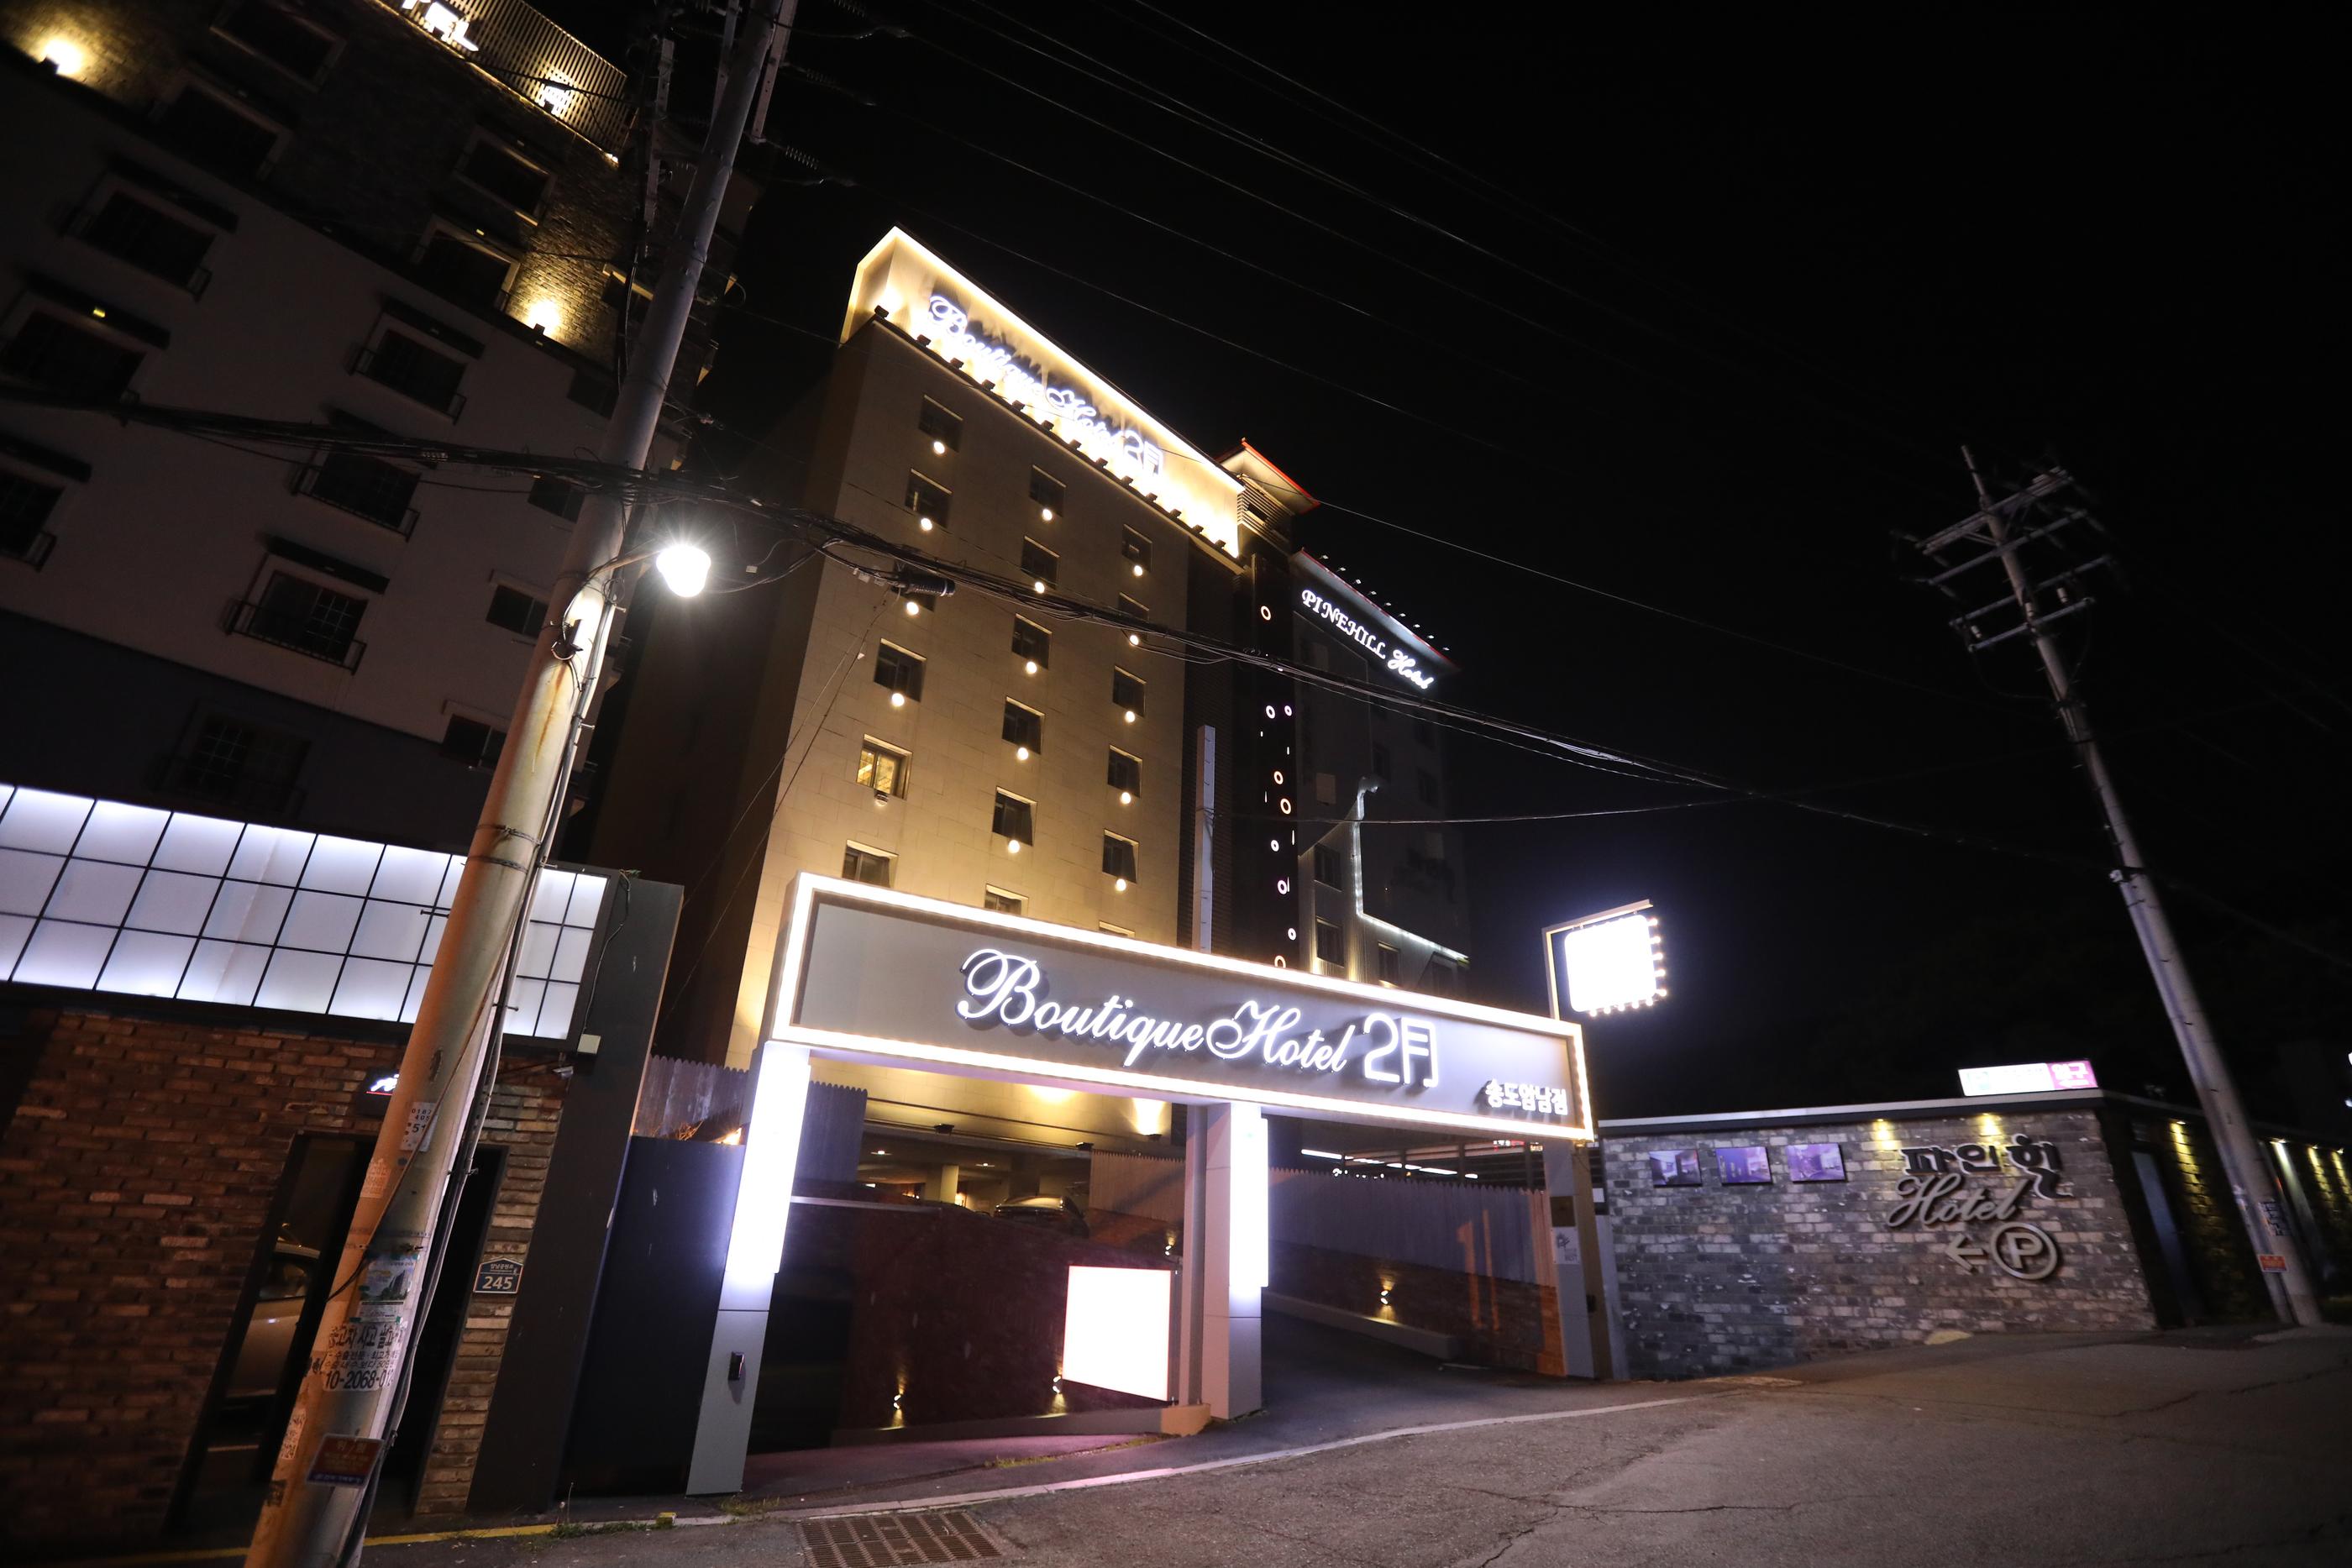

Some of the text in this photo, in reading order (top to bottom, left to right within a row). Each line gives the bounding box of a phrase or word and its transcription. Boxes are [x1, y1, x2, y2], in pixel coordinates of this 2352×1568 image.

[1302, 590, 1435, 690] PINEHILL Hotel
[957, 948, 1205, 1067] Boutique
[1205, 1000, 1356, 1072] Hotel
[1485, 1078, 1568, 1115] 송도암남점
[1899, 1134, 2073, 1200] 파인힐
[1887, 1173, 2031, 1227] Hotel
[482, 1276, 513, 1289] 245
